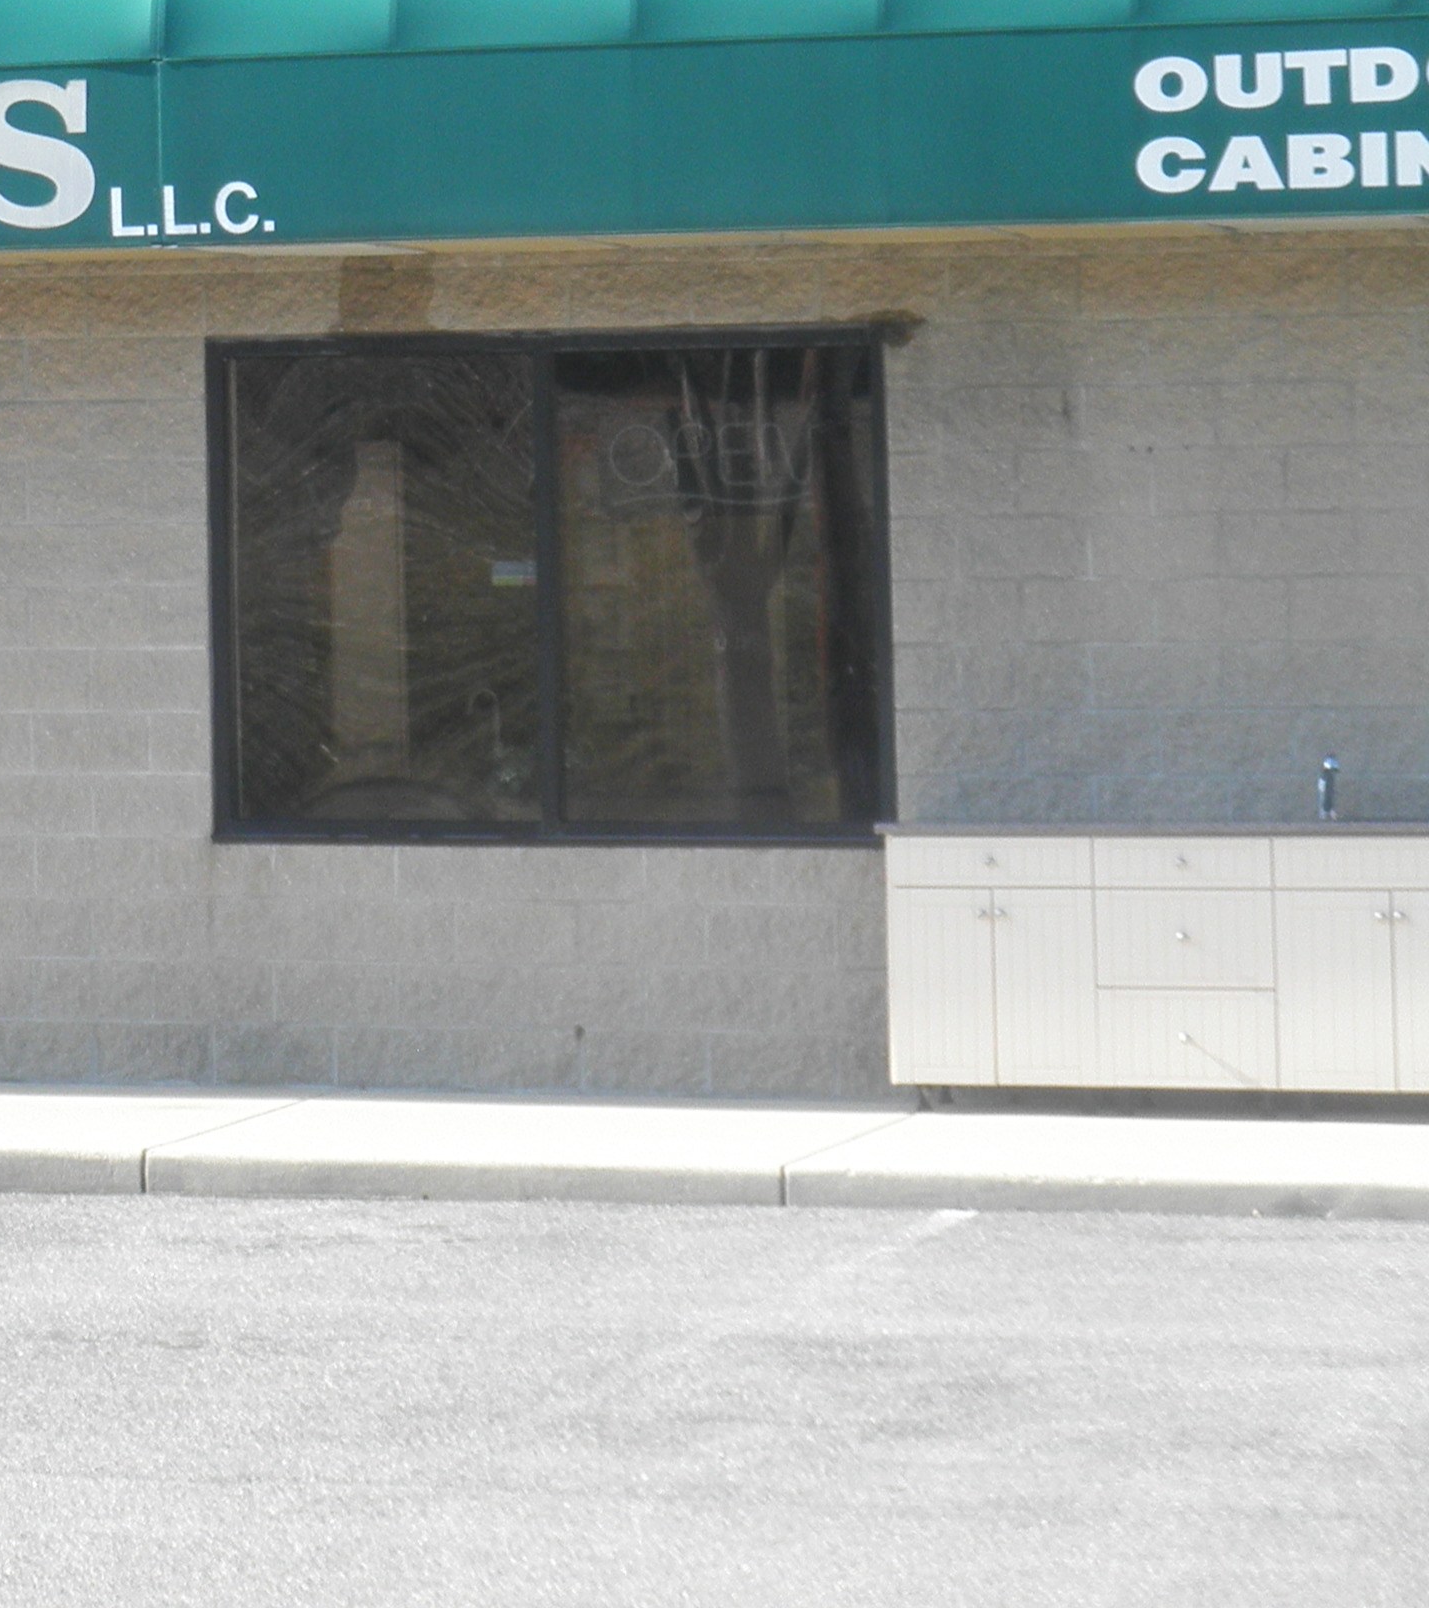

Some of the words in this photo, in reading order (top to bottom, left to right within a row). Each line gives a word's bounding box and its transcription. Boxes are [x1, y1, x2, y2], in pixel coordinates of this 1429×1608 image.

[1133, 46, 1429, 113] OUTD
[109, 180, 276, 238] L.L.C.
[608, 422, 813, 488] OPEN
